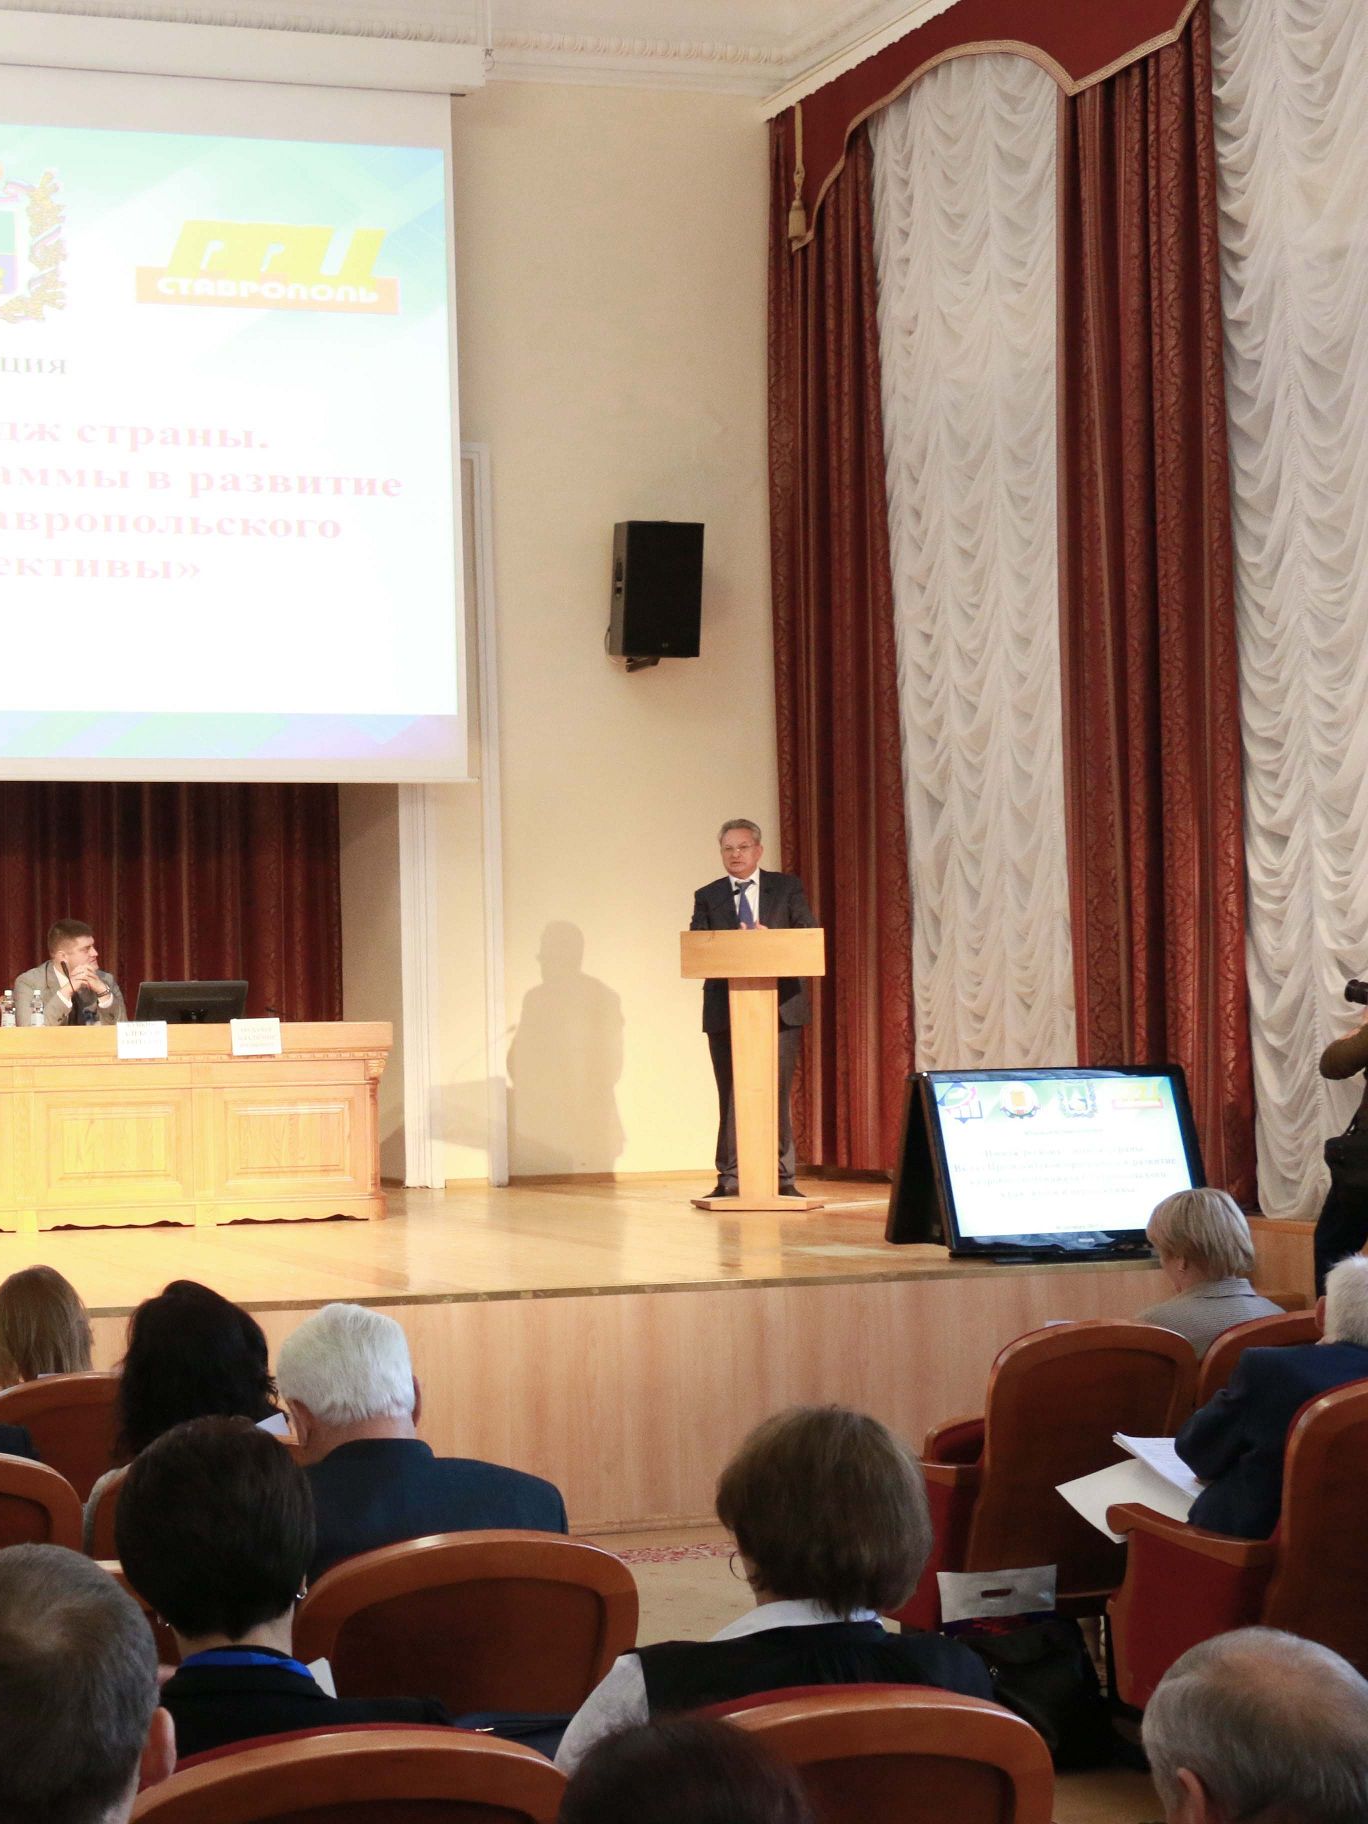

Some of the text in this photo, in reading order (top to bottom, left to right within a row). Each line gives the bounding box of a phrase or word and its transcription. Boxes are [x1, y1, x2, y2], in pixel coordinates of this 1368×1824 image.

[75, 424, 270, 453] страны.
[146, 470, 171, 490] в
[188, 471, 404, 499] развитие
